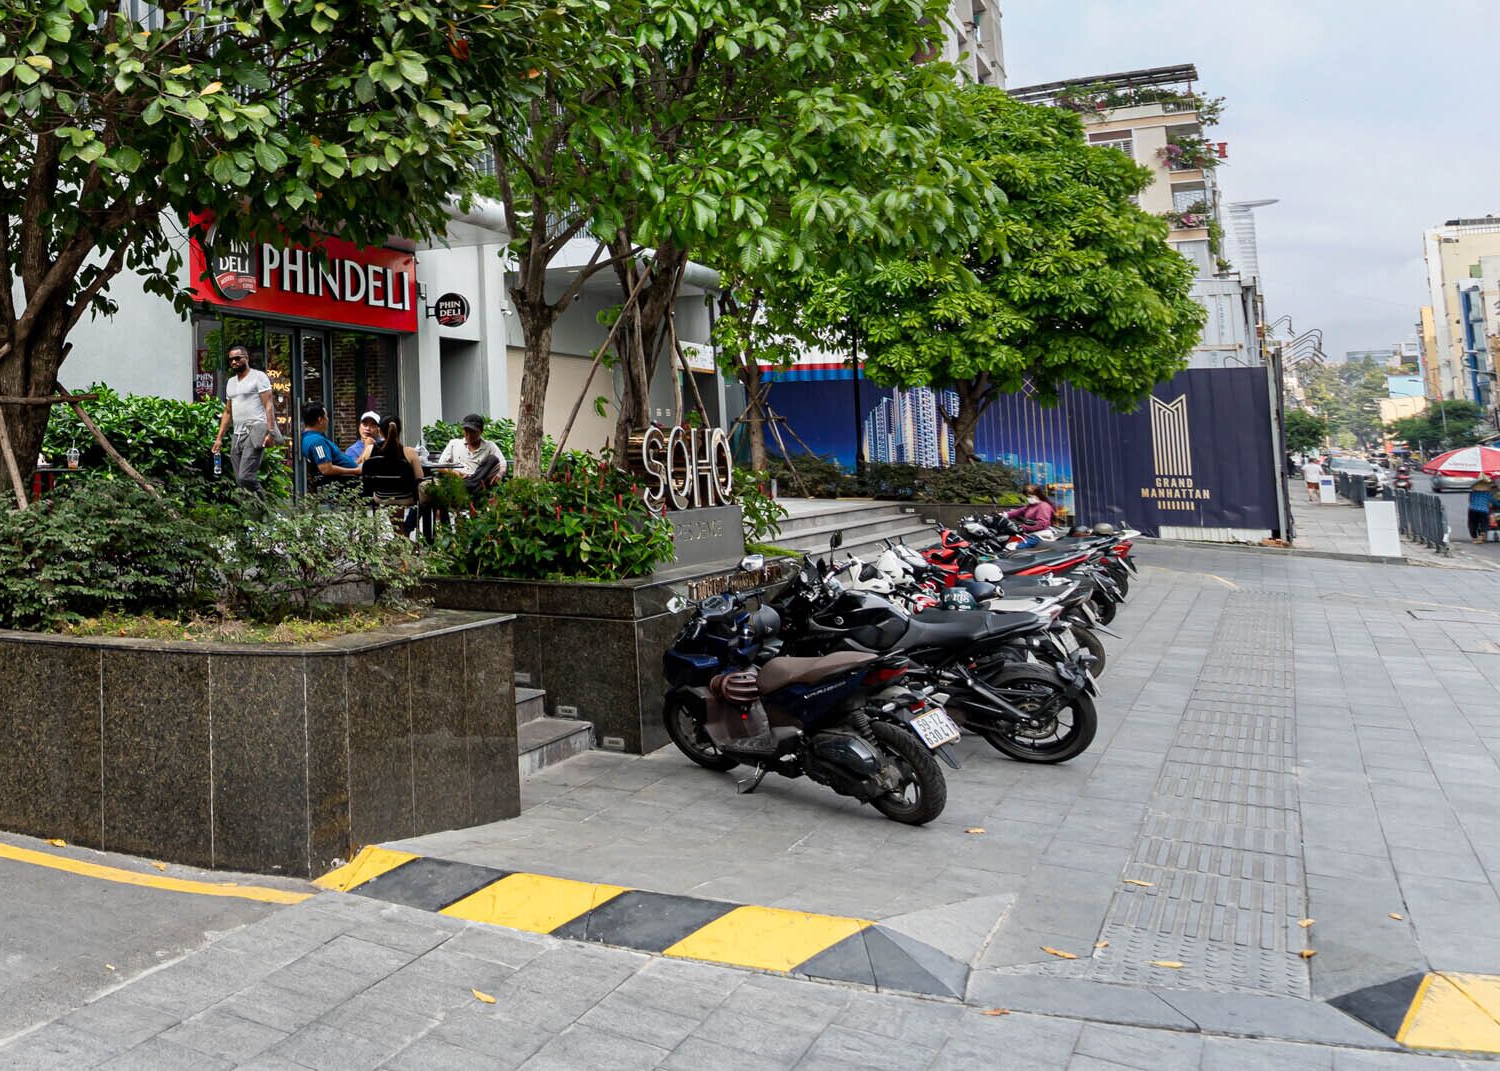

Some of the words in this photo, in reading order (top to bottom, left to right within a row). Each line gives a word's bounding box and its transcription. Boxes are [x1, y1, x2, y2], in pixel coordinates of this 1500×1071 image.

[219, 255, 249, 274] DELI
[263, 243, 410, 310] PHINDELI
[439, 300, 461, 309] PHIN
[440, 309, 460, 317] DELI
[642, 425, 733, 513] SOHO
[1155, 477, 1193, 488] GRAND
[1141, 488, 1211, 499] MANHATTAN
